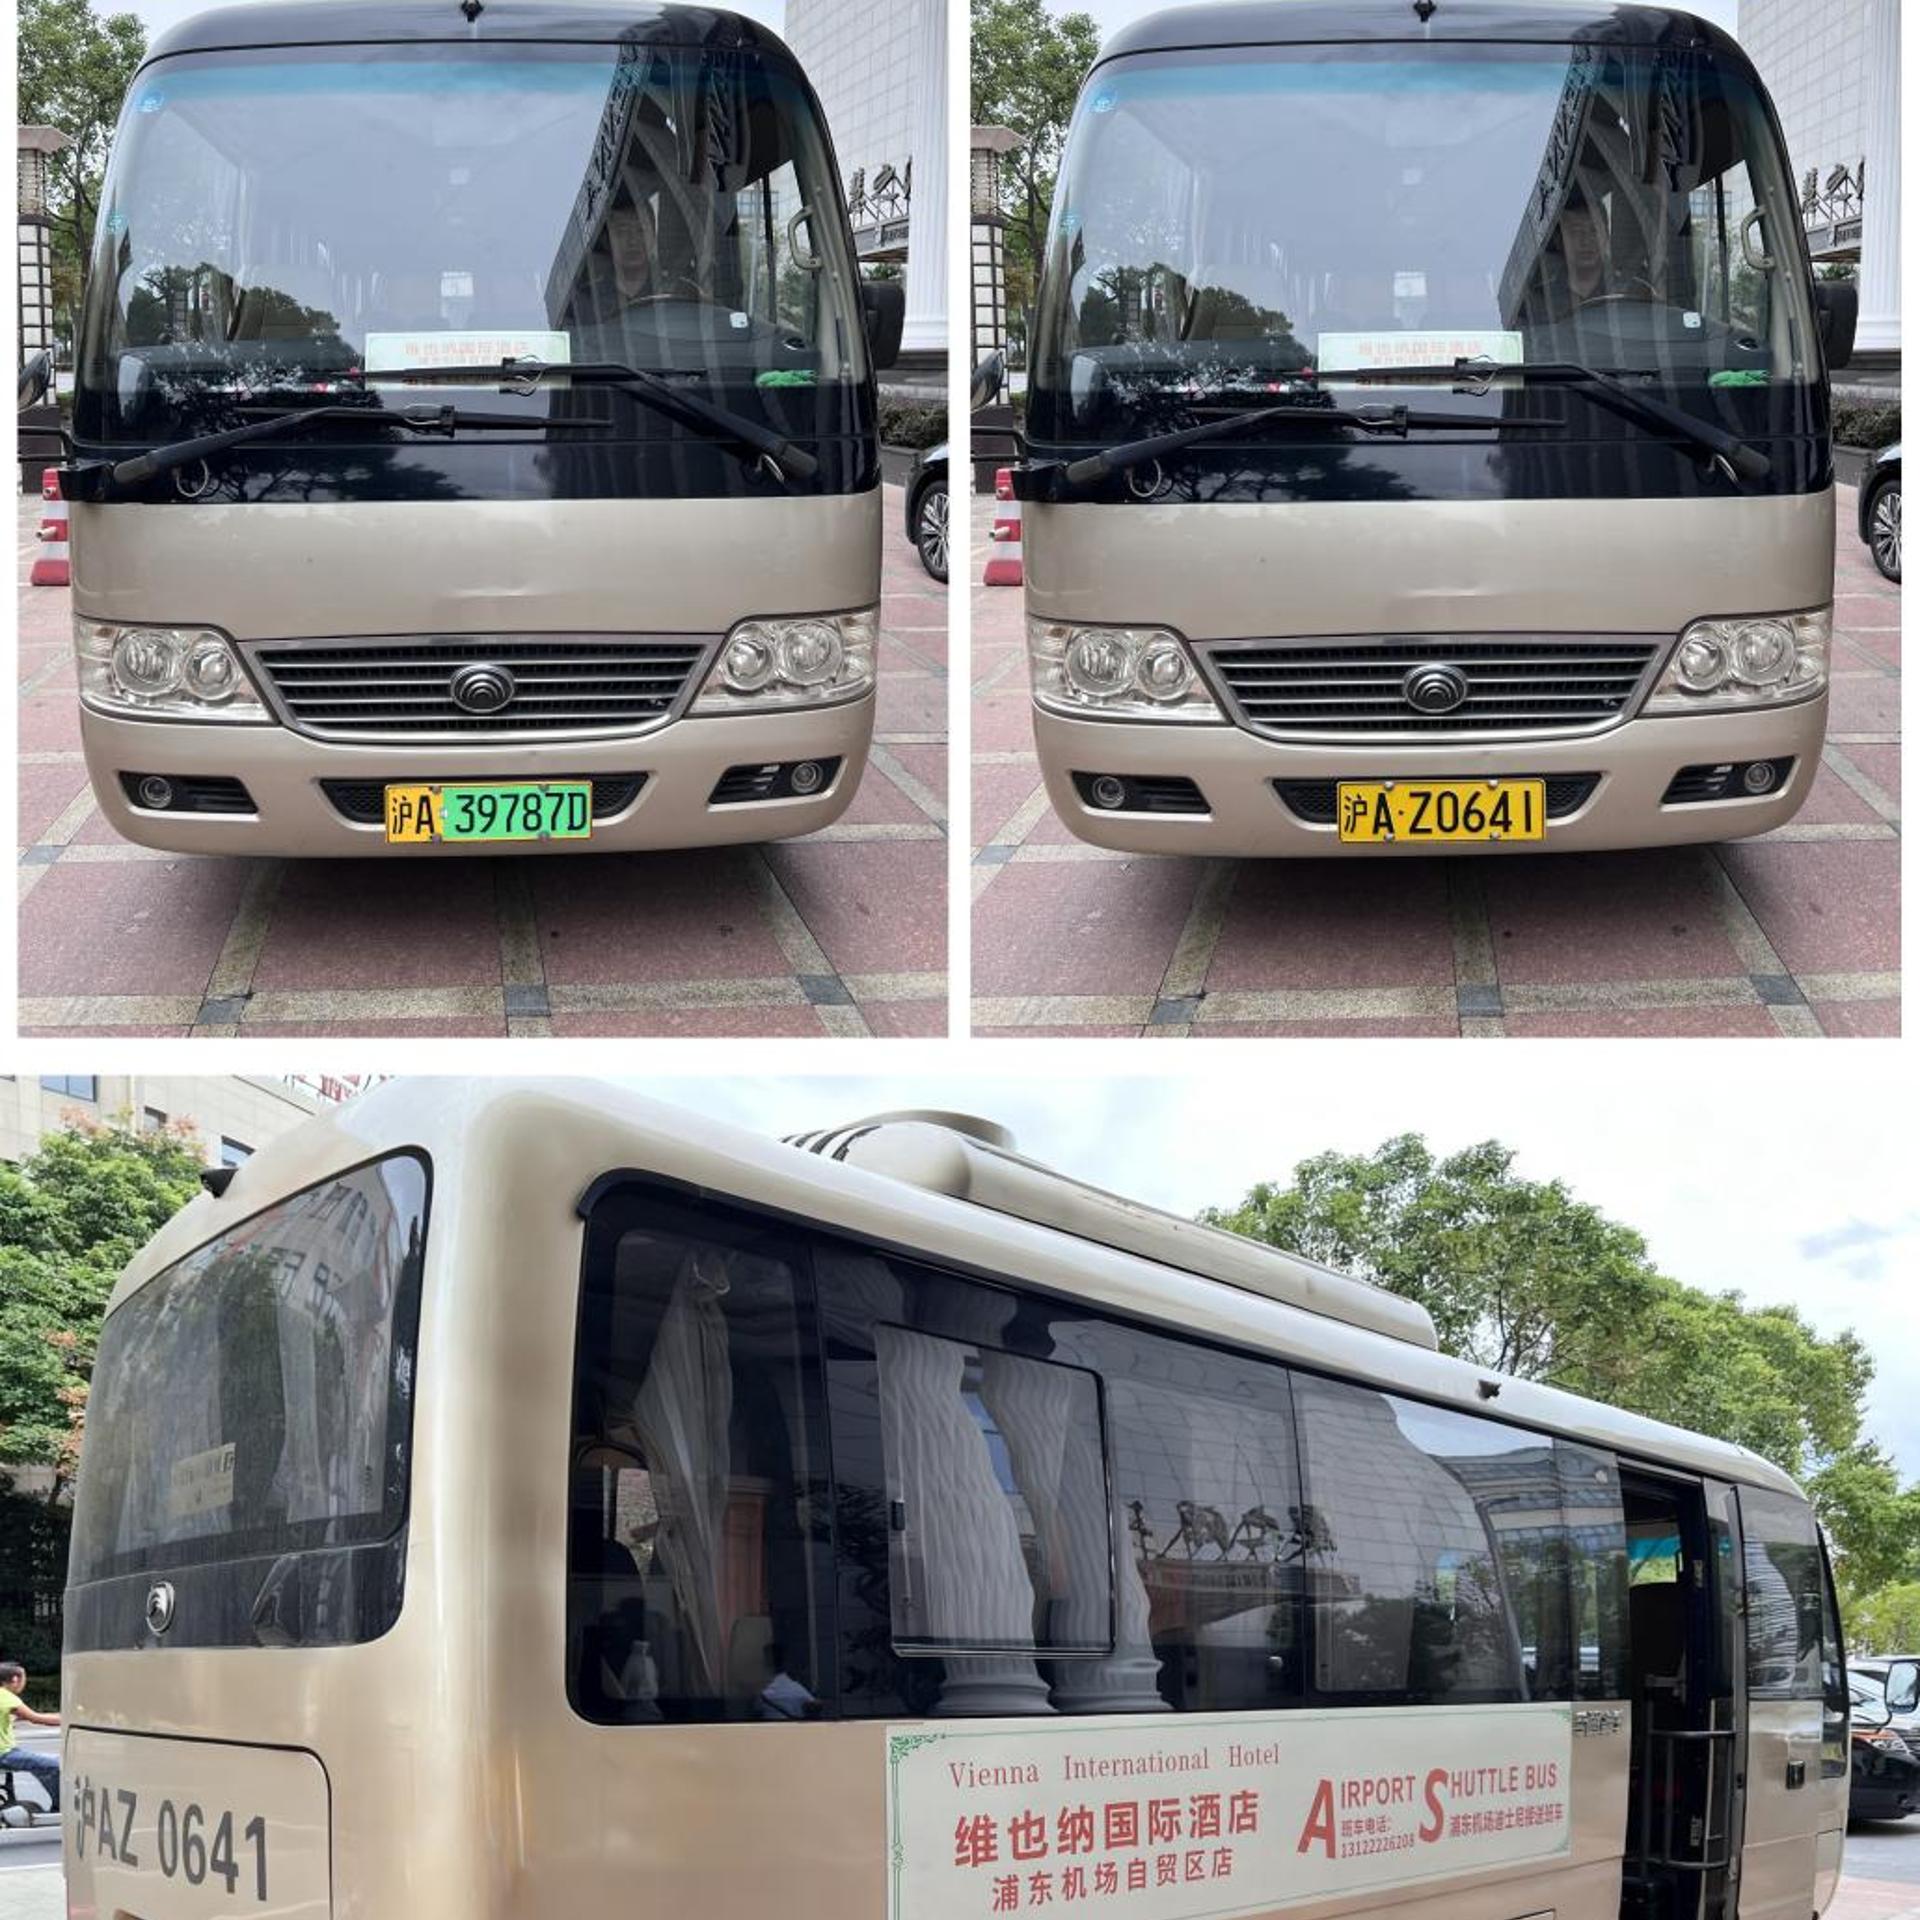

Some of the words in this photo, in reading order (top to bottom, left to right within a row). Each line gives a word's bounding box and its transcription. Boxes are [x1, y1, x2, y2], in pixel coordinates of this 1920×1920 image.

[950, 1761, 1040, 1789] Vienna
[1063, 1748, 1209, 1780] International
[1227, 1743, 1280, 1768] Hotel
[1525, 1762, 1558, 1789] BUS
[954, 1789, 1260, 1868] 维也纳国际酒店
[992, 1847, 1233, 1912] 浦东机场自贸区店
